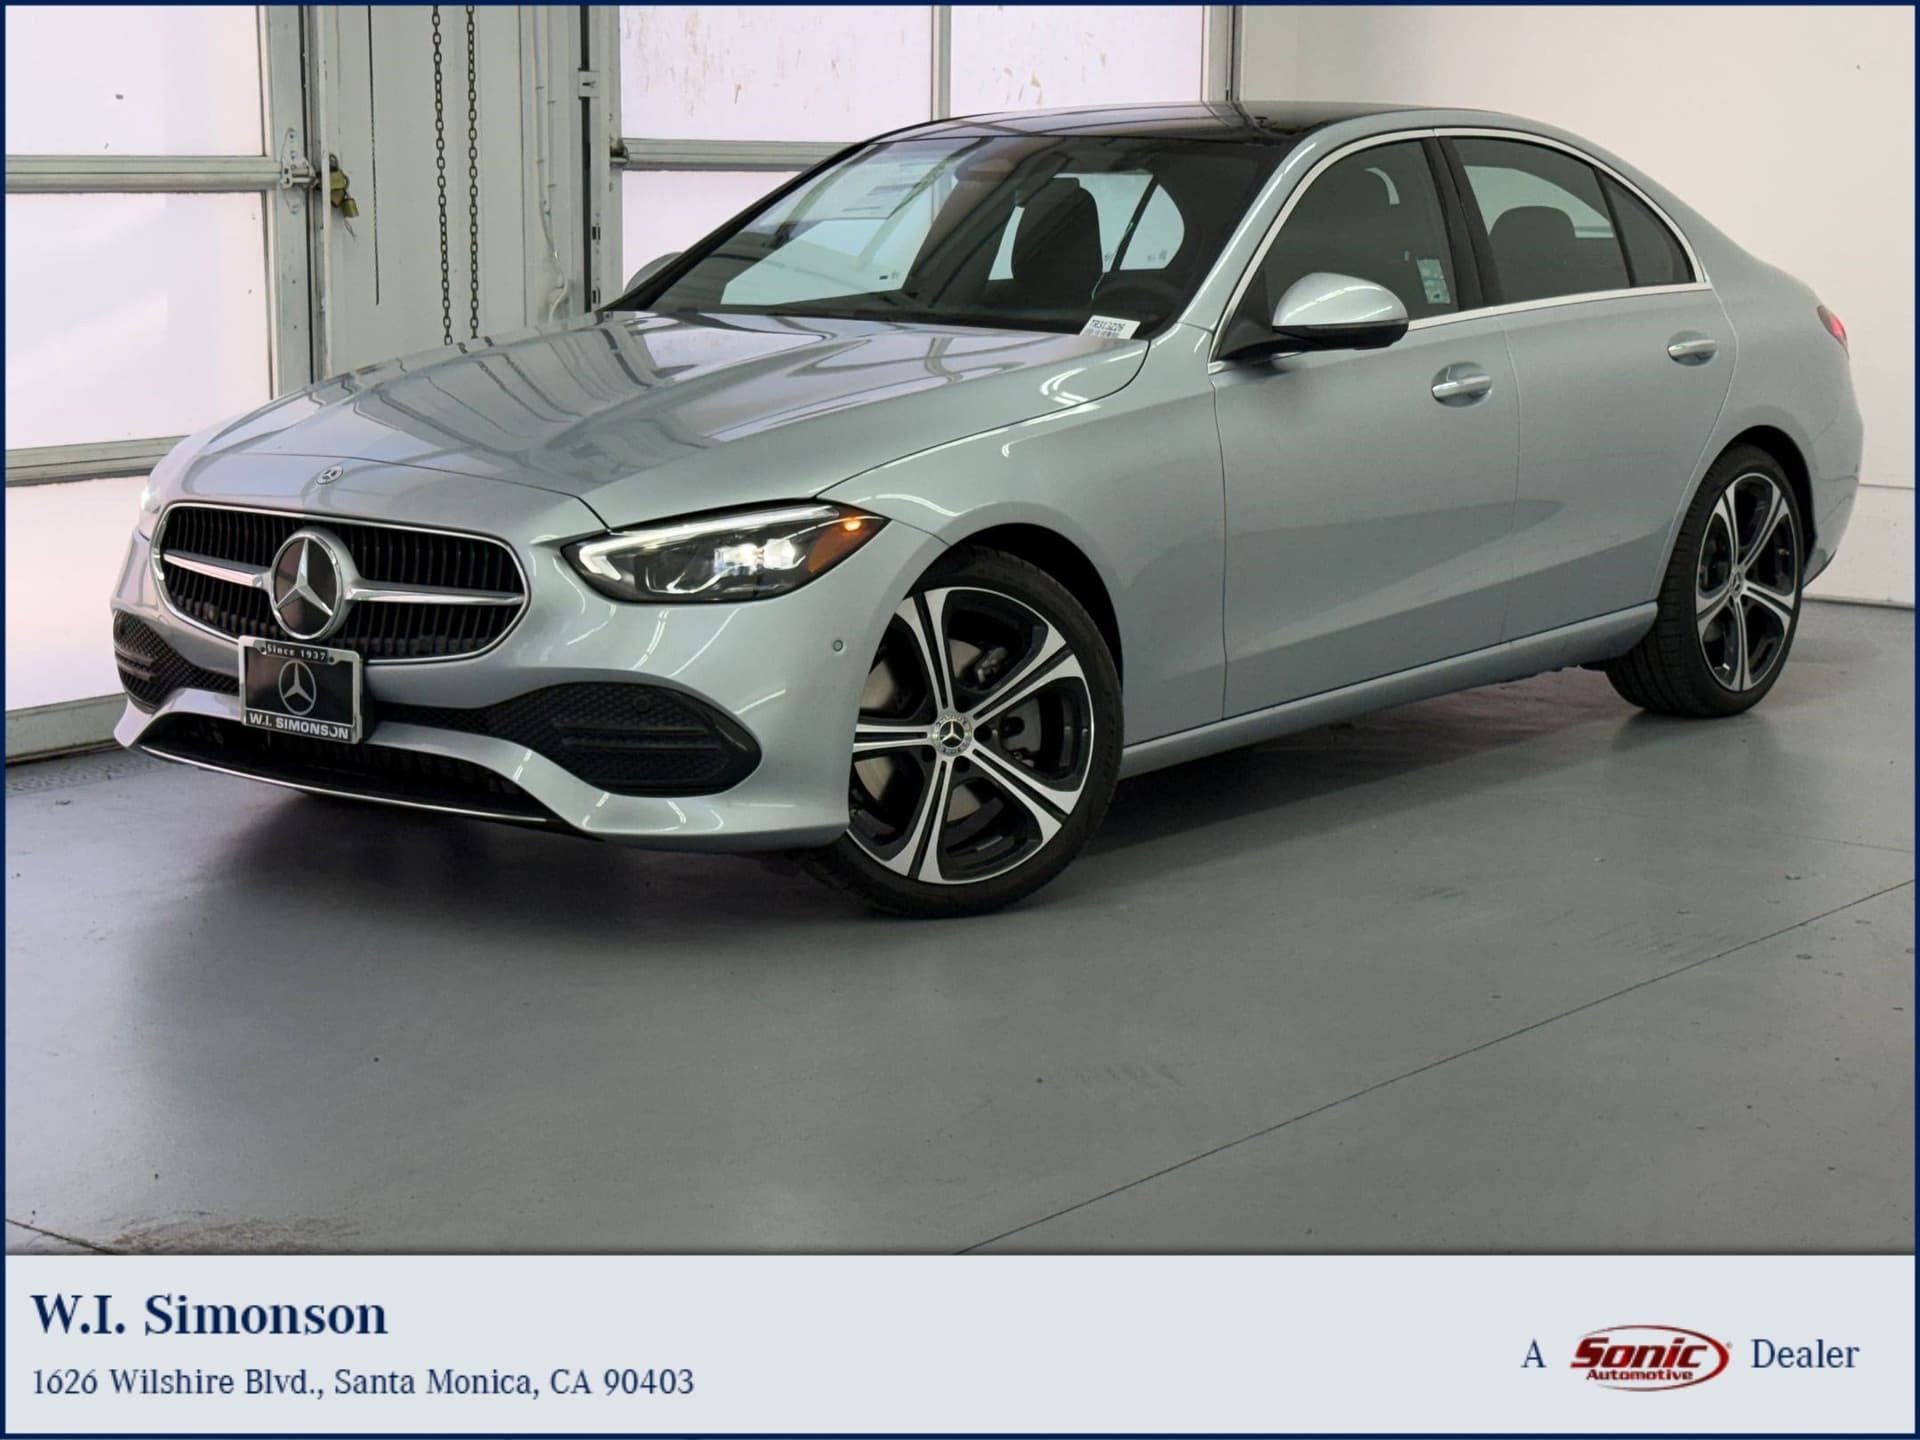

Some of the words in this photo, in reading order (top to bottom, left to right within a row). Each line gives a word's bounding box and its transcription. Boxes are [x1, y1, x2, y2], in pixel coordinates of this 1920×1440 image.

[266, 643, 295, 656] Since
[300, 649, 327, 660] 1937
[249, 712, 272, 727] W.I.
[275, 717, 349, 740] SIMONSON
